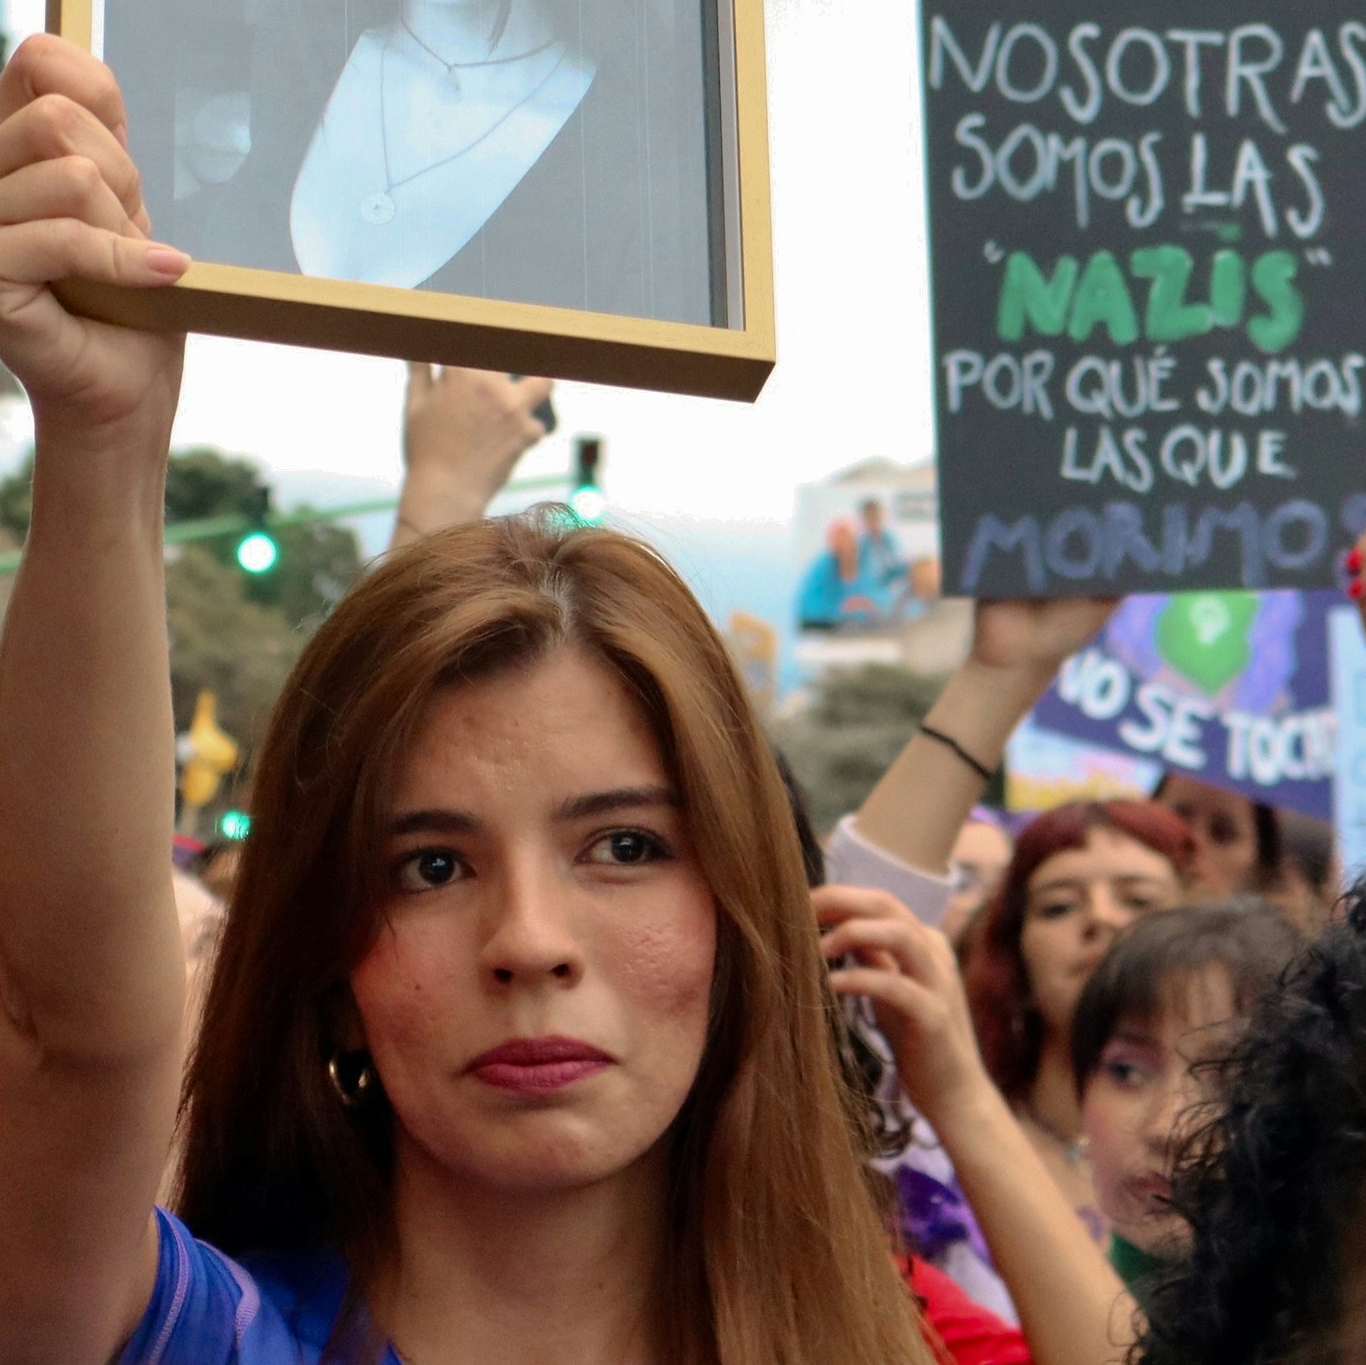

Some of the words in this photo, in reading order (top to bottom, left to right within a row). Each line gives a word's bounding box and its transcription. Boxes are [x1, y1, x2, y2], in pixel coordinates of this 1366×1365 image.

[950, 112, 1165, 230] SOMOS
[1180, 134, 1326, 237] LAS
[943, 349, 1056, 421] POR
[1064, 345, 1183, 420] QUÉ
[1059, 427, 1155, 494] LAS
[1160, 424, 1298, 490] QUE
[1117, 683, 1214, 771] SE
